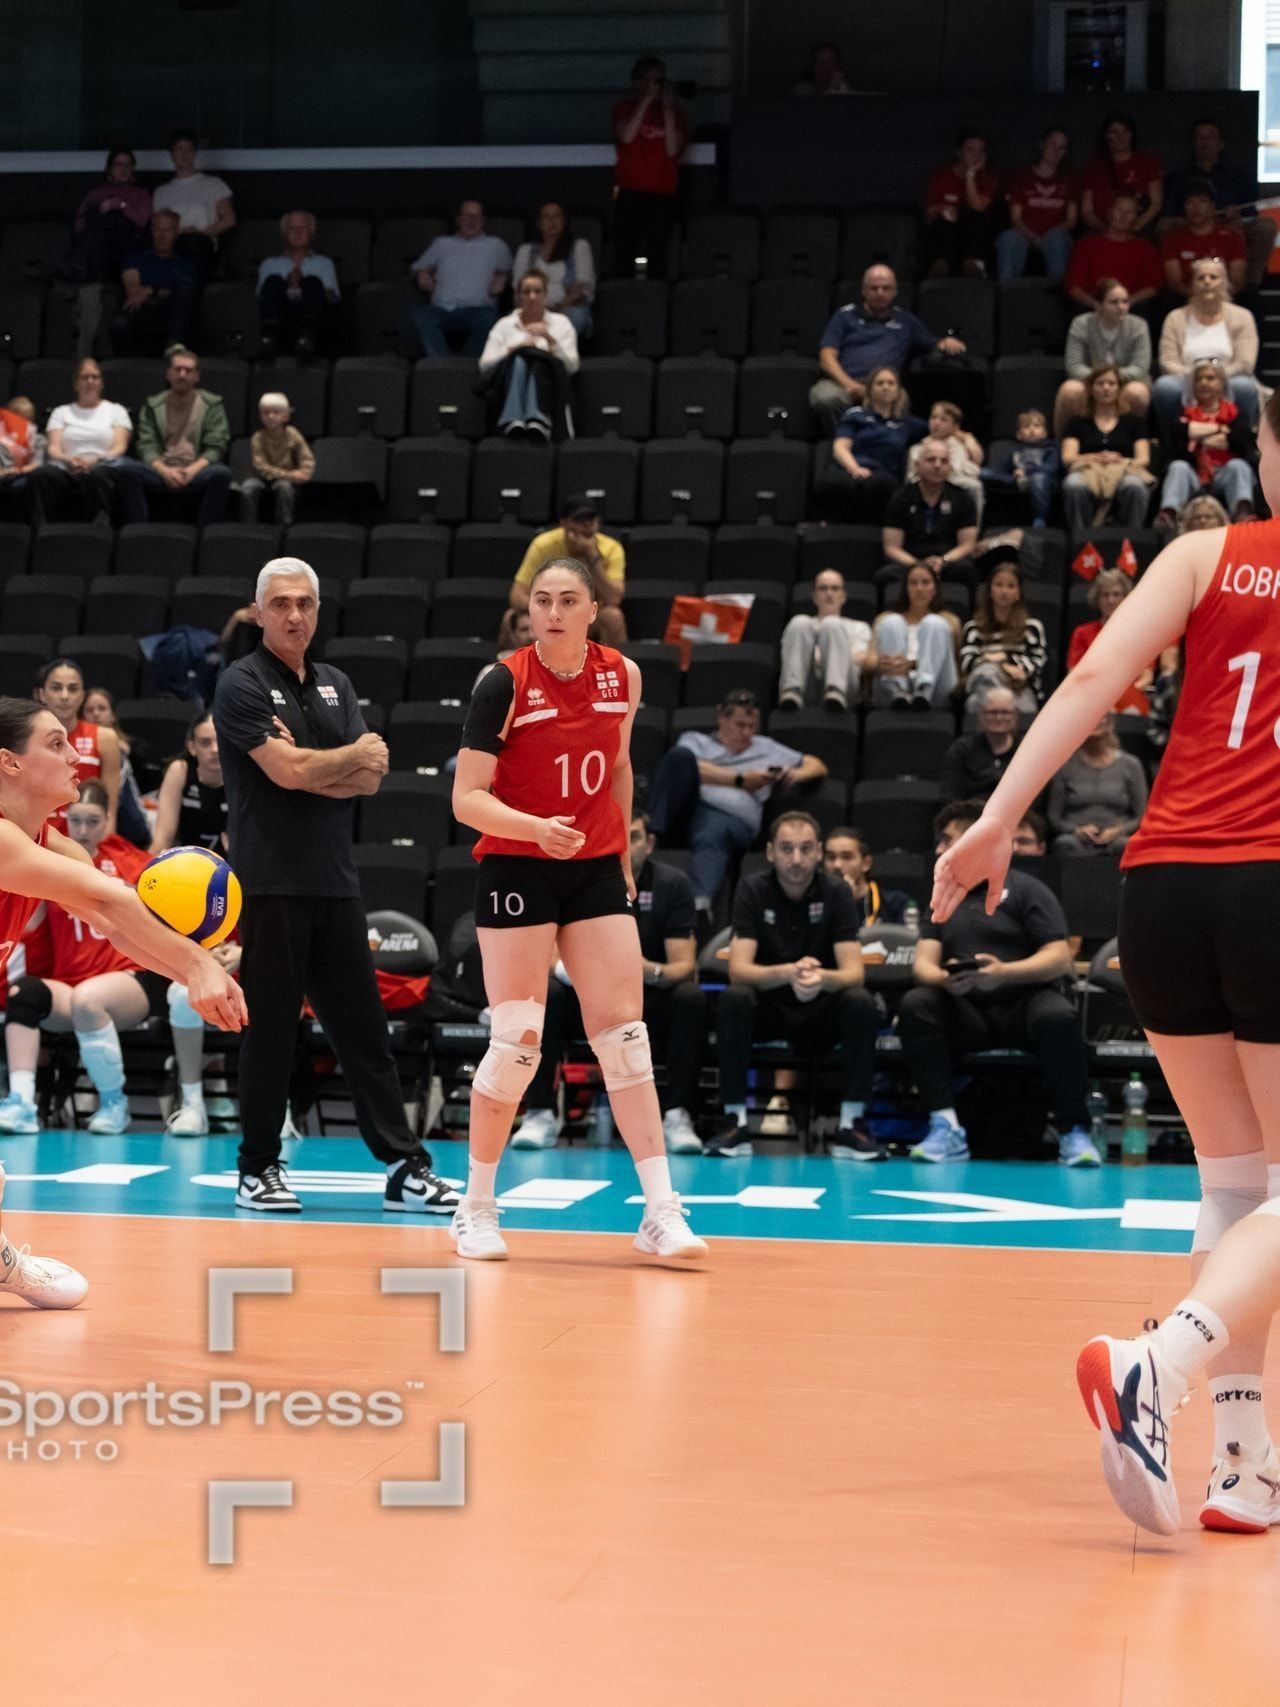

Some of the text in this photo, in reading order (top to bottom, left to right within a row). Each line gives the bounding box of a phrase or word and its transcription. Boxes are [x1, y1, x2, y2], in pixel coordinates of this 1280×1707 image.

[602, 690, 618, 698] GEO
[1228, 651, 1280, 749] 1
[554, 750, 606, 798] 10
[490, 891, 525, 916] 10
